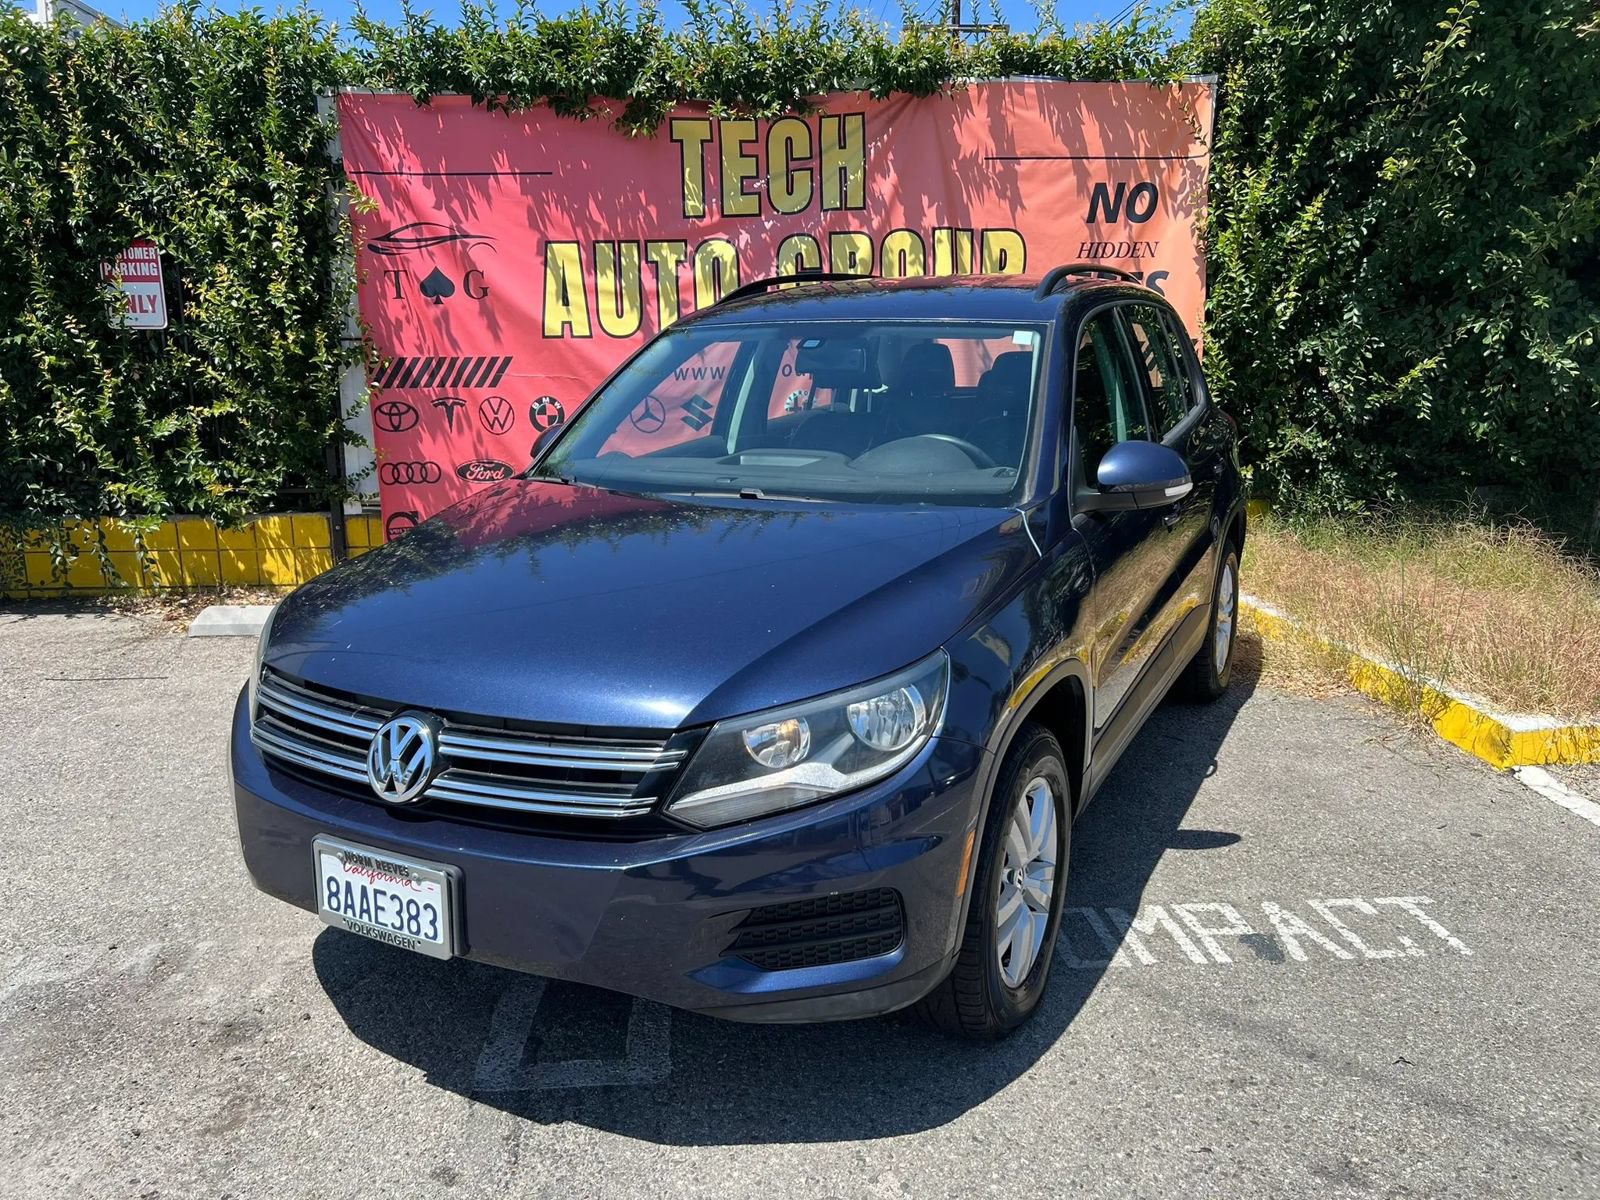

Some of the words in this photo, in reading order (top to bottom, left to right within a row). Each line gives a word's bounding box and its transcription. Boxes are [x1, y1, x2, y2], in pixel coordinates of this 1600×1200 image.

[669, 111, 866, 218] TECH
[1086, 181, 1159, 224] NO
[1076, 241, 1160, 259] HIDDEN
[126, 294, 157, 314] NLY
[542, 237, 741, 339] AUTO
[466, 462, 505, 481] Ford
[342, 860, 422, 893] California
[344, 851, 373, 868] NORM
[375, 859, 410, 878] REEVES
[326, 875, 438, 942] 8AAE383
[346, 919, 416, 951] VOLKSWAGEN
[1056, 895, 1474, 969] OMPACT
